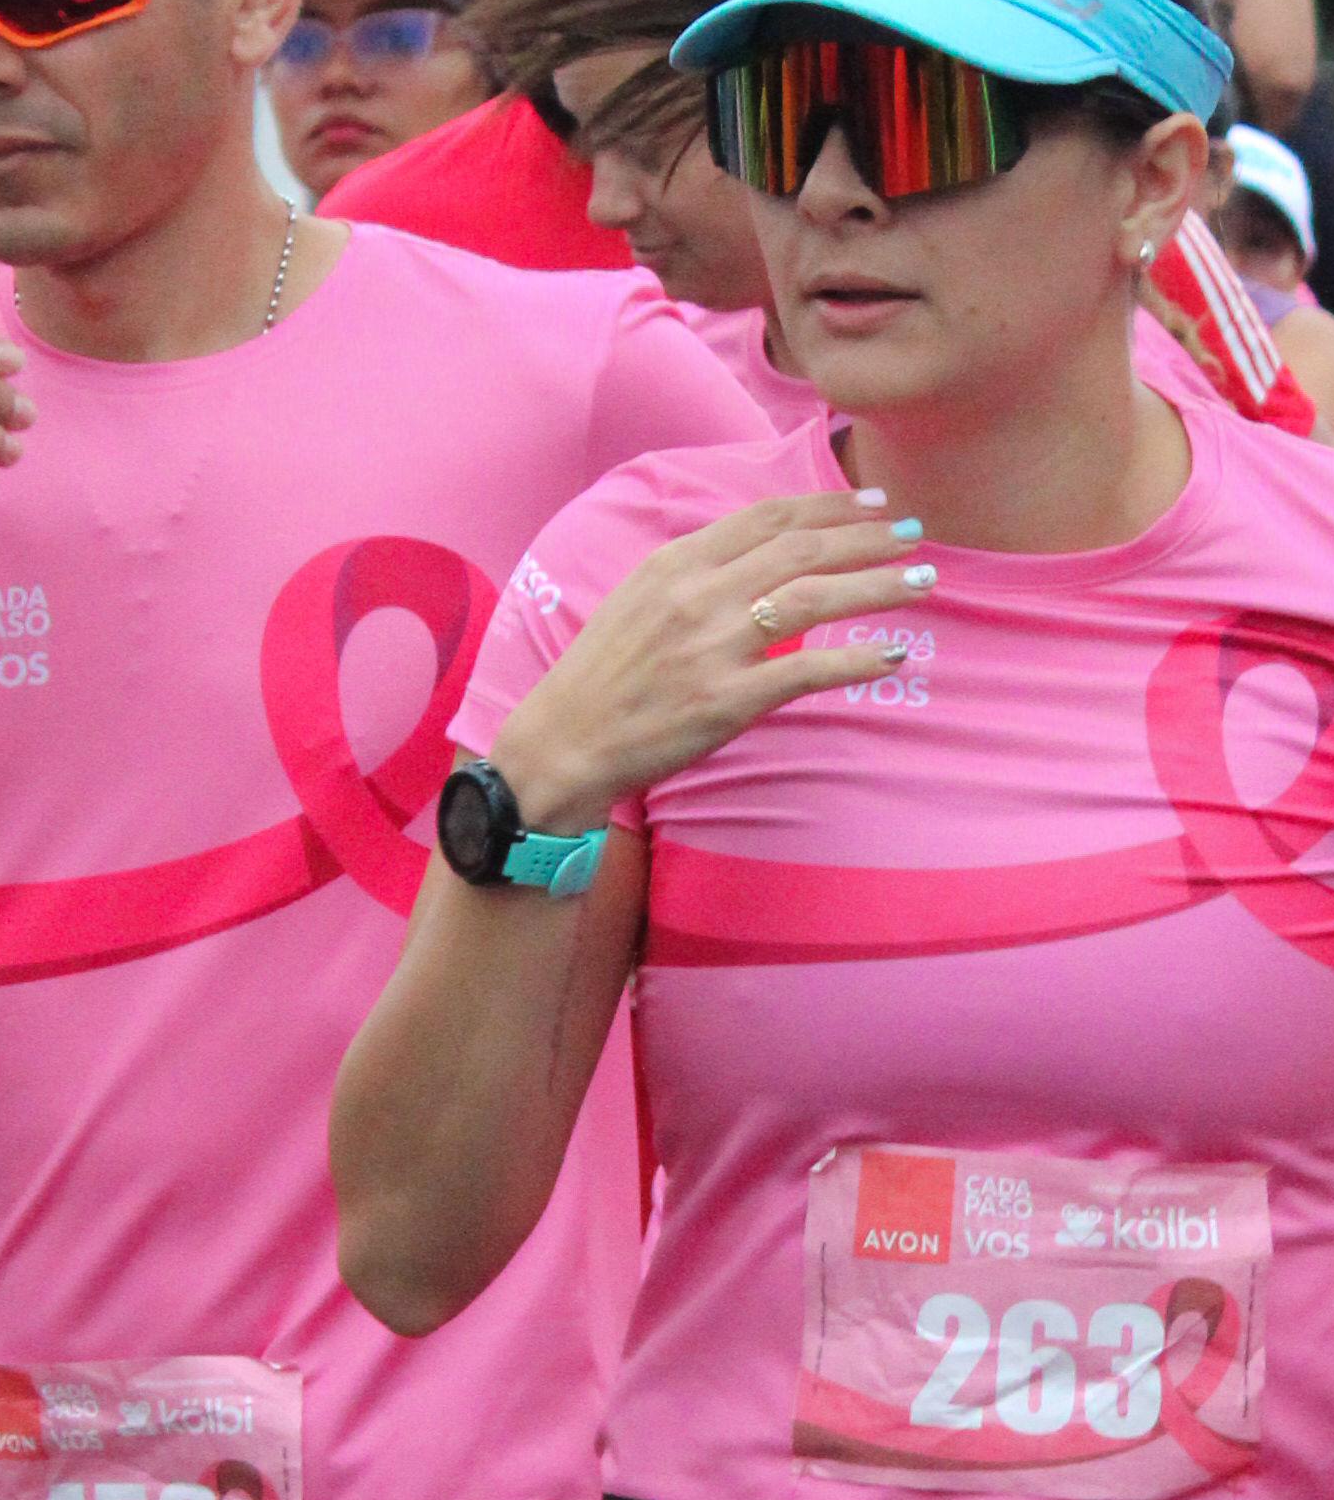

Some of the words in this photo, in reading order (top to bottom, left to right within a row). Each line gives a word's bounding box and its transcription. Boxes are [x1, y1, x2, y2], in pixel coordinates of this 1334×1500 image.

[847, 625, 936, 646] CADA
[844, 675, 931, 708] VOS
[965, 1174, 1031, 1199] CADA
[965, 1194, 1033, 1220] PASO
[862, 1228, 940, 1255] AVON
[1113, 1205, 1219, 1250] kölbi
[964, 1228, 1031, 1260] VOS
[909, 1292, 1165, 1441] 263
[158, 1395, 255, 1435] kölbi
[50, 1428, 104, 1451] VOS
